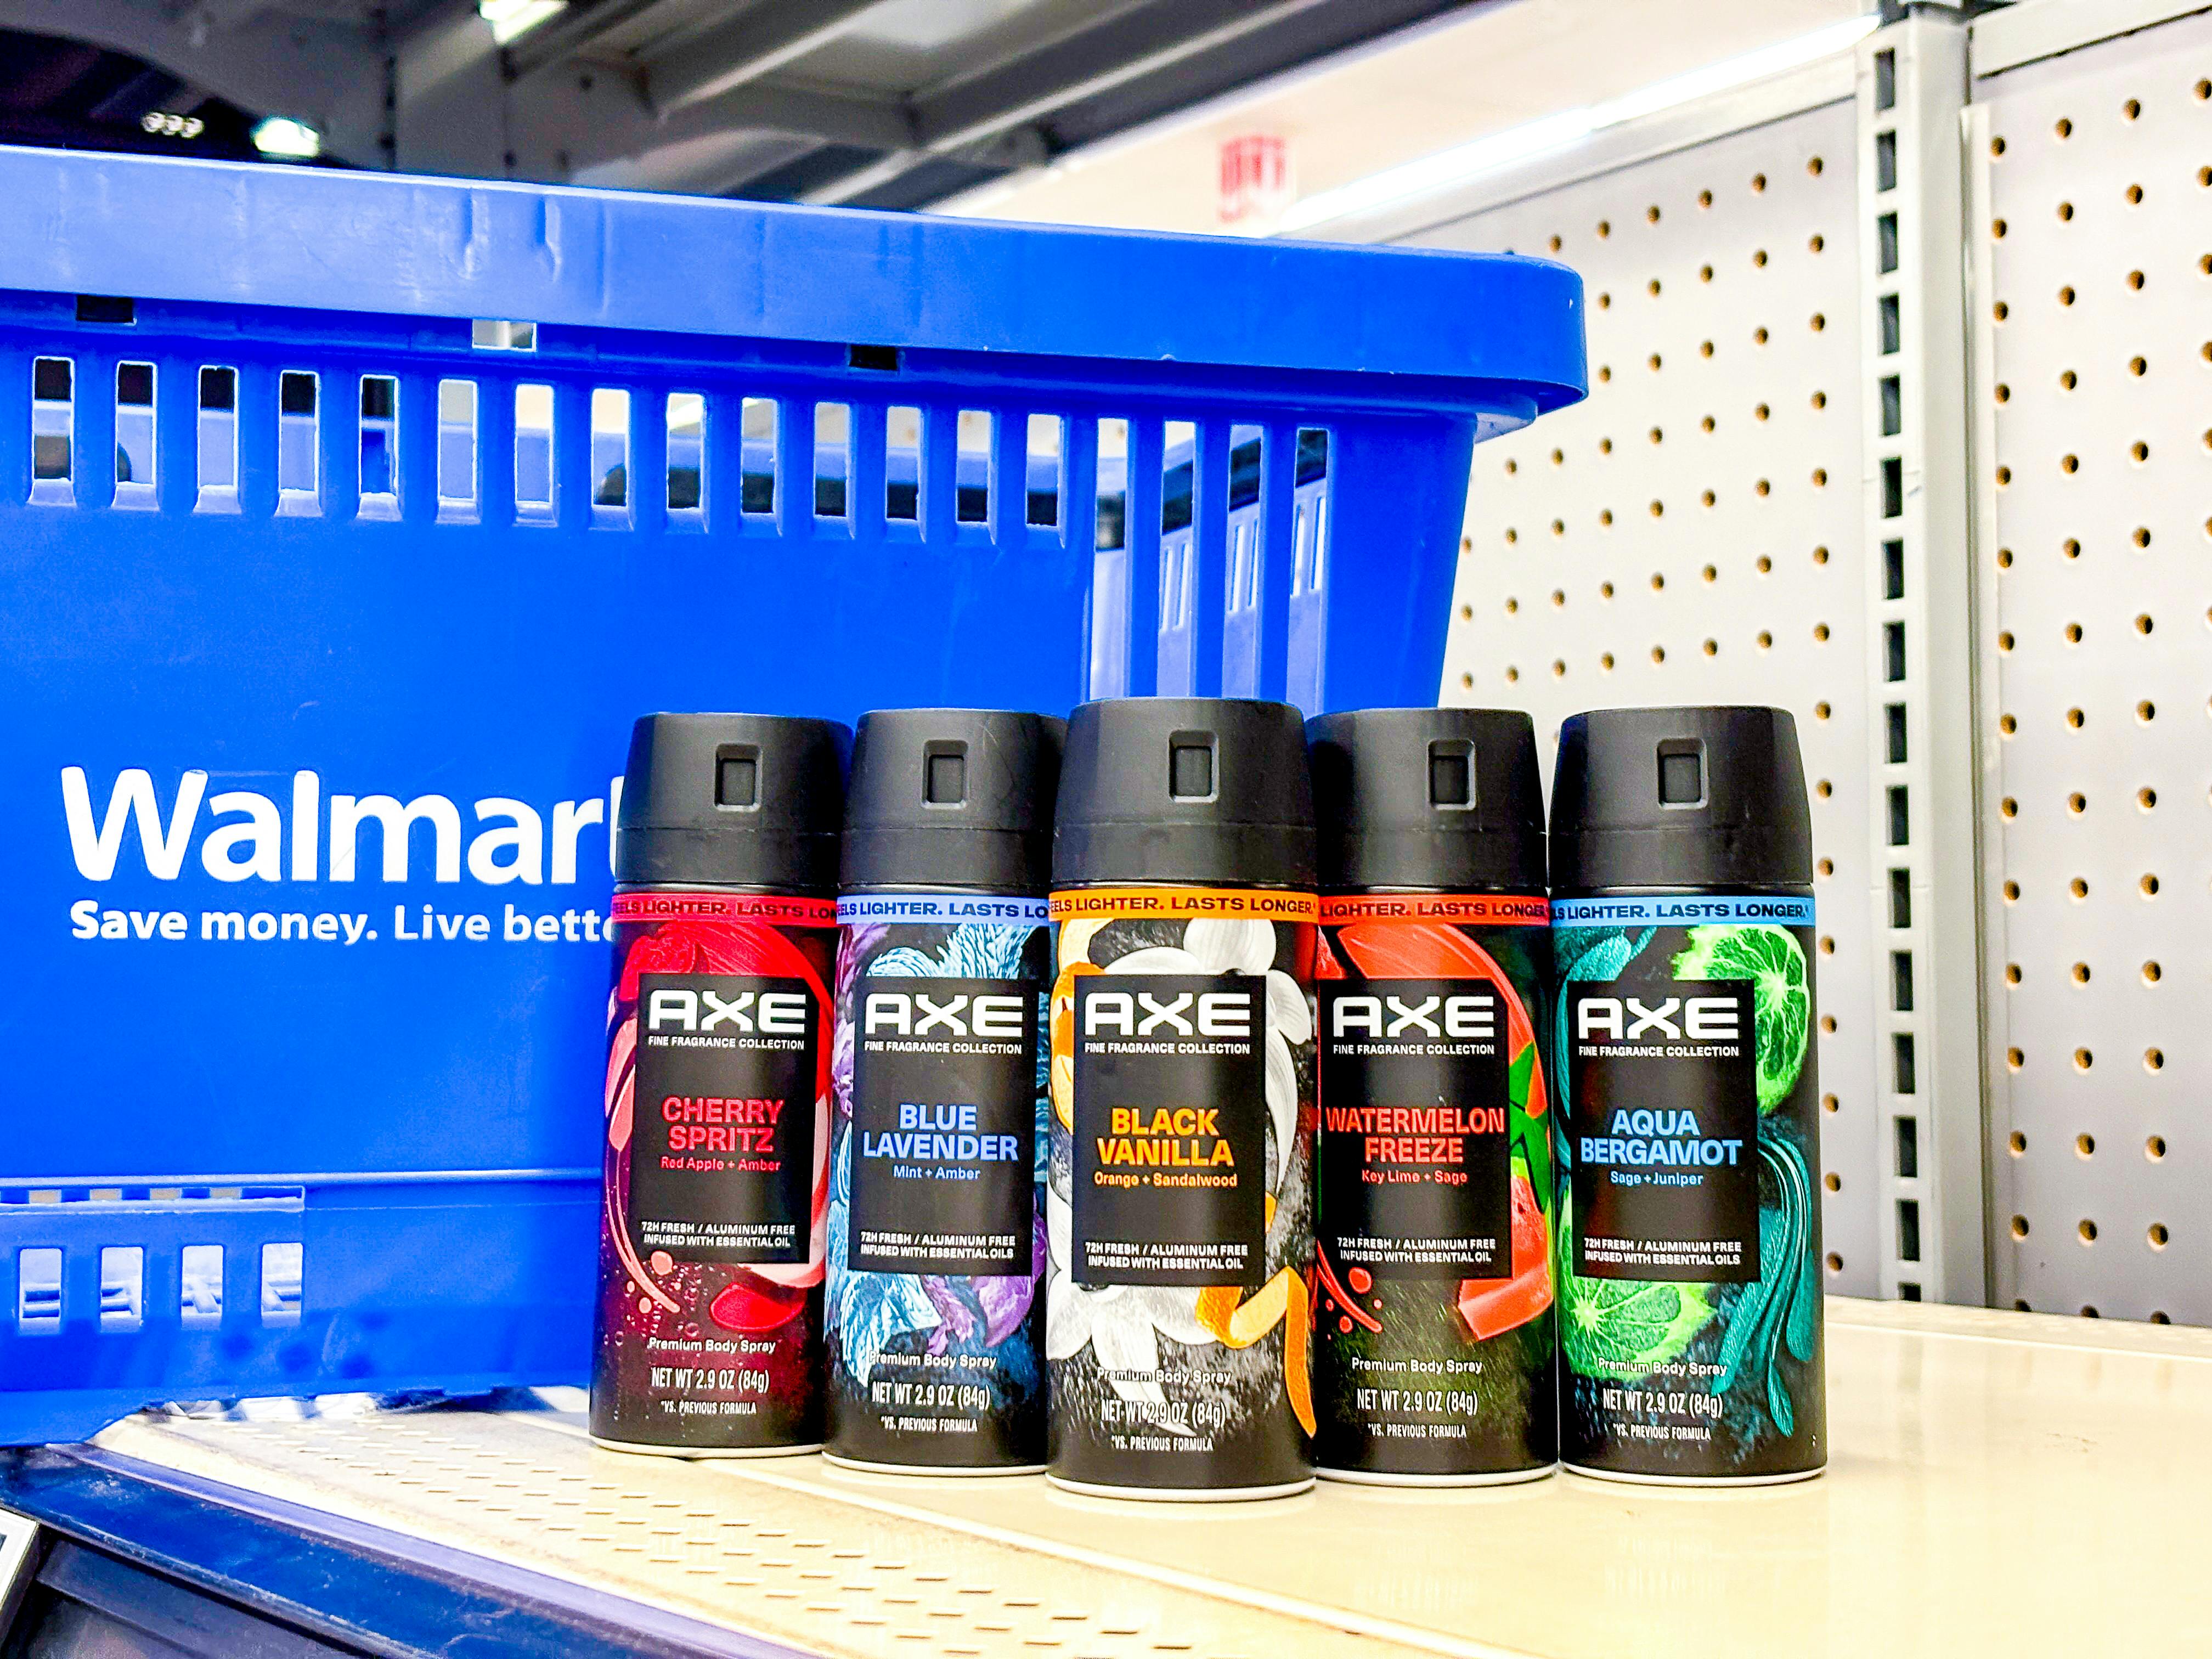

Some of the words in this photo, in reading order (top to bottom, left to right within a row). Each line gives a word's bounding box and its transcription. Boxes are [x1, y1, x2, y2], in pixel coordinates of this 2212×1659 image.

[644, 900, 731, 915] LIGHTER.
[737, 902, 803, 918] LASTS
[860, 902, 943, 916] LIGHTER.
[949, 902, 1019, 917] LASTS
[1076, 897, 1164, 910] LIGHTER.
[1172, 897, 1244, 910] LASTS
[1321, 902, 1411, 917] LIGHTER.
[1417, 902, 1486, 916] LASTS
[1568, 904, 1650, 919] LIGHTER.
[1656, 904, 1730, 917] LASTS
[70, 901, 187, 940] Save
[201, 912, 378, 946] money.
[394, 904, 489, 941] Live
[649, 990, 805, 1032] AXE
[866, 994, 1023, 1037] AXE
[1085, 993, 1250, 1036] AXE
[1333, 996, 1494, 1037] AXE
[1578, 998, 1738, 1039] AXE
[648, 1036, 669, 1046] FINE
[672, 1037, 736, 1048] FRAGRANCE
[738, 1039, 804, 1049] COLLECTION
[865, 1041, 884, 1051] FINE
[887, 1041, 950, 1053] FRAGRANCE
[952, 1043, 1022, 1054] COLLECTION
[1085, 1043, 1105, 1053] FINE
[1108, 1043, 1175, 1053] FRAGRANCE
[1178, 1043, 1250, 1054] COLLECTION
[1334, 1045, 1354, 1054] FINE
[1358, 1045, 1423, 1055] FRAGRANCE
[1427, 1045, 1494, 1054] COLLECTION
[1579, 1046, 1597, 1056] FINE
[1600, 1046, 1663, 1057] FRAGRANCE
[1667, 1047, 1739, 1057] COLLECTION
[663, 1097, 783, 1124] CHERRY
[900, 1104, 977, 1132] BLUE
[1112, 1108, 1219, 1136] BLACK
[1326, 1107, 1504, 1135] WATERMELON
[1612, 1110, 1700, 1137] AQUA
[669, 1125, 774, 1153] SPRITZ
[864, 1132, 1018, 1160] LAVENDER
[1097, 1138, 1234, 1166] VANILLA
[1365, 1137, 1463, 1164] FREEZE
[1581, 1138, 1742, 1165] BERGAMOT
[661, 1156, 684, 1169] Red
[686, 1157, 724, 1172] Apple
[737, 1159, 781, 1171] Amber
[894, 1165, 922, 1178] Mint
[935, 1166, 980, 1180] Amber
[1094, 1172, 1139, 1188] Orange
[1153, 1172, 1237, 1187] Sandalwood
[1362, 1170, 1385, 1184] Key
[1388, 1170, 1420, 1183] Lime
[1435, 1170, 1467, 1186] Sage
[1611, 1171, 1641, 1186] Sage
[1654, 1172, 1703, 1187] Juniper
[642, 1222, 659, 1234] 72H
[661, 1222, 695, 1234] FRESH
[706, 1224, 768, 1235] ALUMINUM
[771, 1225, 795, 1234] FREE
[644, 1234, 685, 1245] INFUSED
[687, 1236, 714, 1246] WITH
[716, 1237, 773, 1247] ESSENTIAL
[775, 1237, 790, 1246] OIL
[861, 1232, 877, 1243] 72H
[879, 1233, 911, 1245] FRESH
[922, 1234, 986, 1246] ALUMINUM
[989, 1236, 1015, 1246] FREE
[1338, 1237, 1355, 1248] 72H
[1358, 1238, 1392, 1249] FRESH
[1403, 1239, 1468, 1250] ALUMINUM
[1470, 1239, 1496, 1249] FREE
[1584, 1238, 1600, 1248] 72H
[1602, 1239, 1634, 1250] FRESH
[1645, 1241, 1711, 1252] ALUMINUM
[1713, 1242, 1741, 1252] FREE
[861, 1245, 899, 1256] INFUSED
[900, 1246, 927, 1257] WITH
[929, 1246, 989, 1259] ESSENTIAL
[990, 1248, 1014, 1259] OILS
[1086, 1242, 1103, 1254] 72H
[1105, 1243, 1139, 1255] FRESH
[1150, 1244, 1217, 1256] ALUMINUM
[1221, 1245, 1248, 1256] FREE
[1340, 1249, 1383, 1261] INFUSED
[1384, 1251, 1413, 1262] WITH
[1415, 1251, 1474, 1262] ESSENTIAL
[1475, 1252, 1492, 1263] OIL
[1088, 1255, 1130, 1268] INFUSED
[1131, 1256, 1160, 1269] WITH
[1163, 1257, 1224, 1269] ESSENTIAL
[1225, 1257, 1244, 1269] OIL
[1585, 1251, 1622, 1262] INFUSED
[1623, 1252, 1651, 1264] WITH
[1653, 1254, 1714, 1265] ESSENTIAL
[1715, 1254, 1740, 1265] OILS
[648, 1337, 702, 1351] Premium
[706, 1340, 737, 1353] Body
[739, 1339, 776, 1354] Spray
[869, 1350, 921, 1365] Premium
[924, 1353, 957, 1369] Body
[960, 1355, 997, 1370] Spray
[1352, 1357, 1407, 1372] Premium
[1410, 1359, 1443, 1374] Body
[1446, 1359, 1482, 1374] Spray
[1598, 1357, 1649, 1373] Premium
[1652, 1360, 1686, 1376] Body
[1689, 1362, 1727, 1377] Spray
[651, 1367, 673, 1387] NET
[676, 1368, 693, 1389] WT
[696, 1369, 715, 1390] 2.9
[719, 1369, 735, 1391] OZ
[738, 1369, 769, 1392] (84g)
[1097, 1367, 1152, 1382] Premium
[1155, 1369, 1189, 1386] Body
[1193, 1369, 1232, 1386] Spray
[872, 1381, 892, 1403] NET
[895, 1383, 912, 1404] WT
[915, 1385, 934, 1406] 2.9
[938, 1385, 954, 1406] OZ
[957, 1385, 990, 1410] (84g)
[1357, 1389, 1378, 1409] NET
[1381, 1390, 1399, 1411] WT
[1403, 1391, 1423, 1412] 2.9
[1426, 1391, 1442, 1412] OZ
[1447, 1391, 1477, 1415] (84g)
[1603, 1388, 1622, 1410] NET
[1624, 1390, 1643, 1412] WT
[1645, 1392, 1666, 1413] 2.9
[1669, 1393, 1686, 1414] OZ
[1689, 1393, 1723, 1419] (84g)
[679, 1401, 717, 1414] PREVIOUS
[720, 1402, 756, 1415] FORMULA
[1101, 1400, 1122, 1422] NET
[1125, 1401, 1144, 1423] WT
[1147, 1402, 1169, 1424] 2.9
[1171, 1402, 1188, 1424] OZ
[1192, 1402, 1226, 1429] (84g)
[899, 1417, 936, 1431] PREVIOUS
[939, 1419, 977, 1432] FORMULA
[1387, 1424, 1426, 1438] PREVIOUS
[1429, 1424, 1466, 1438] FORMULA
[1631, 1425, 1669, 1440] PREVIOUS
[1672, 1427, 1711, 1441] FORMULA
[1131, 1436, 1170, 1451] PREVIOUS
[1173, 1437, 1214, 1451] FORMULA
